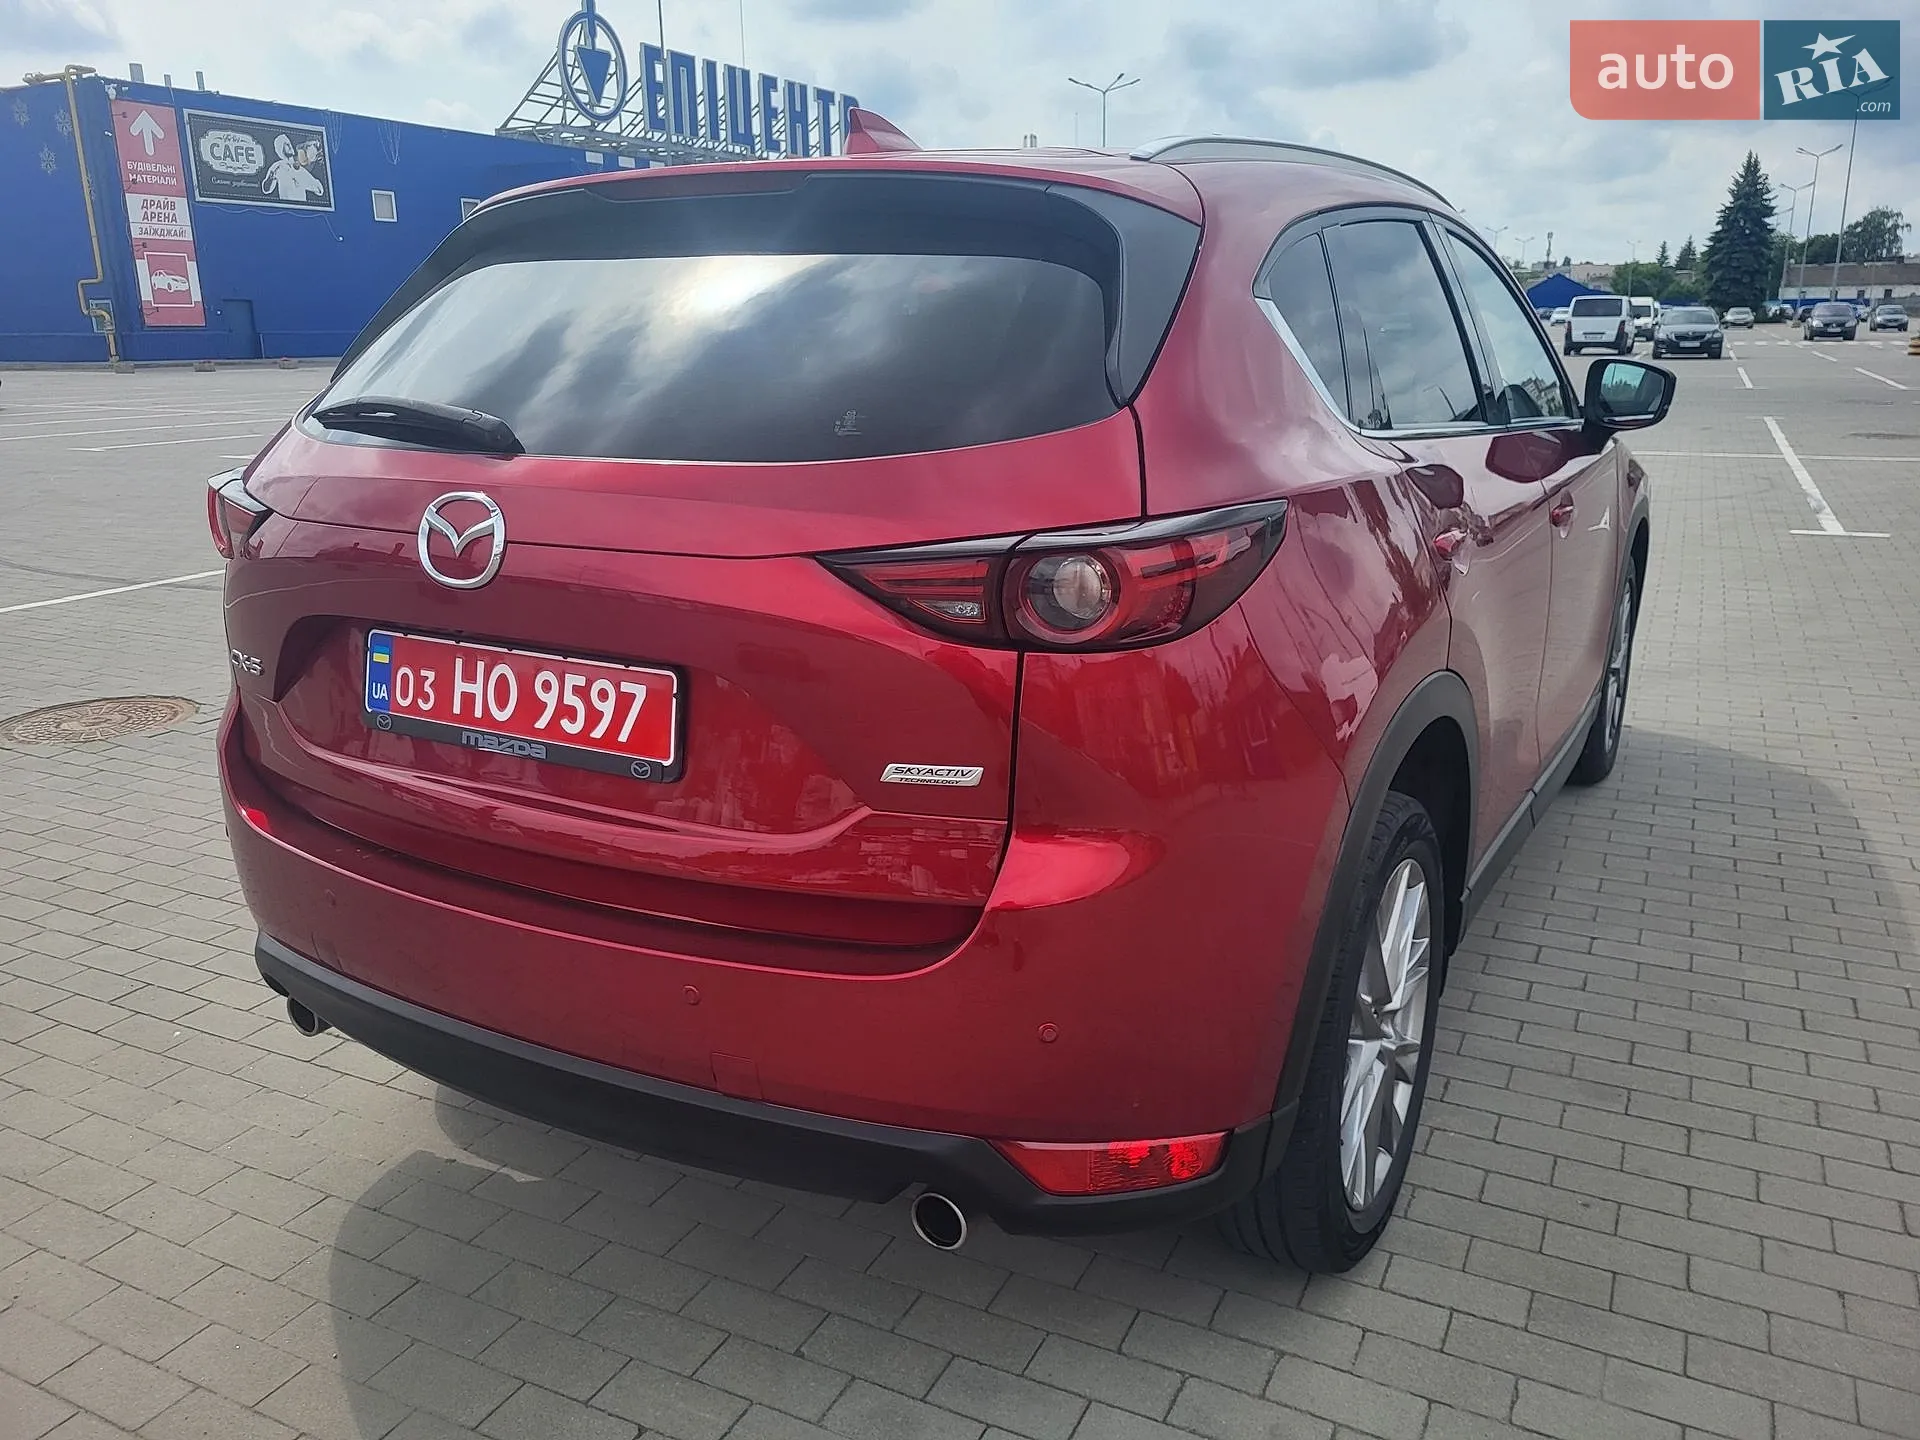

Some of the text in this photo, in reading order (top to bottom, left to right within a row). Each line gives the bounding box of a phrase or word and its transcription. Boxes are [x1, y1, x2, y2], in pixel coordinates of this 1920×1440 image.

[209, 142, 257, 165] CAFE
[127, 161, 176, 173] БУДІВЕЛЬНІ
[128, 173, 177, 186] МАТЕРІАЛИ
[141, 197, 176, 211] ДРАЙВ
[142, 210, 178, 224] АРЕНА
[138, 225, 187, 239] ЗАЇЖДЖАЙ!
[371, 681, 389, 702] UA
[395, 656, 648, 744] 03 HO 9597
[892, 766, 973, 777] SKYACTIV
